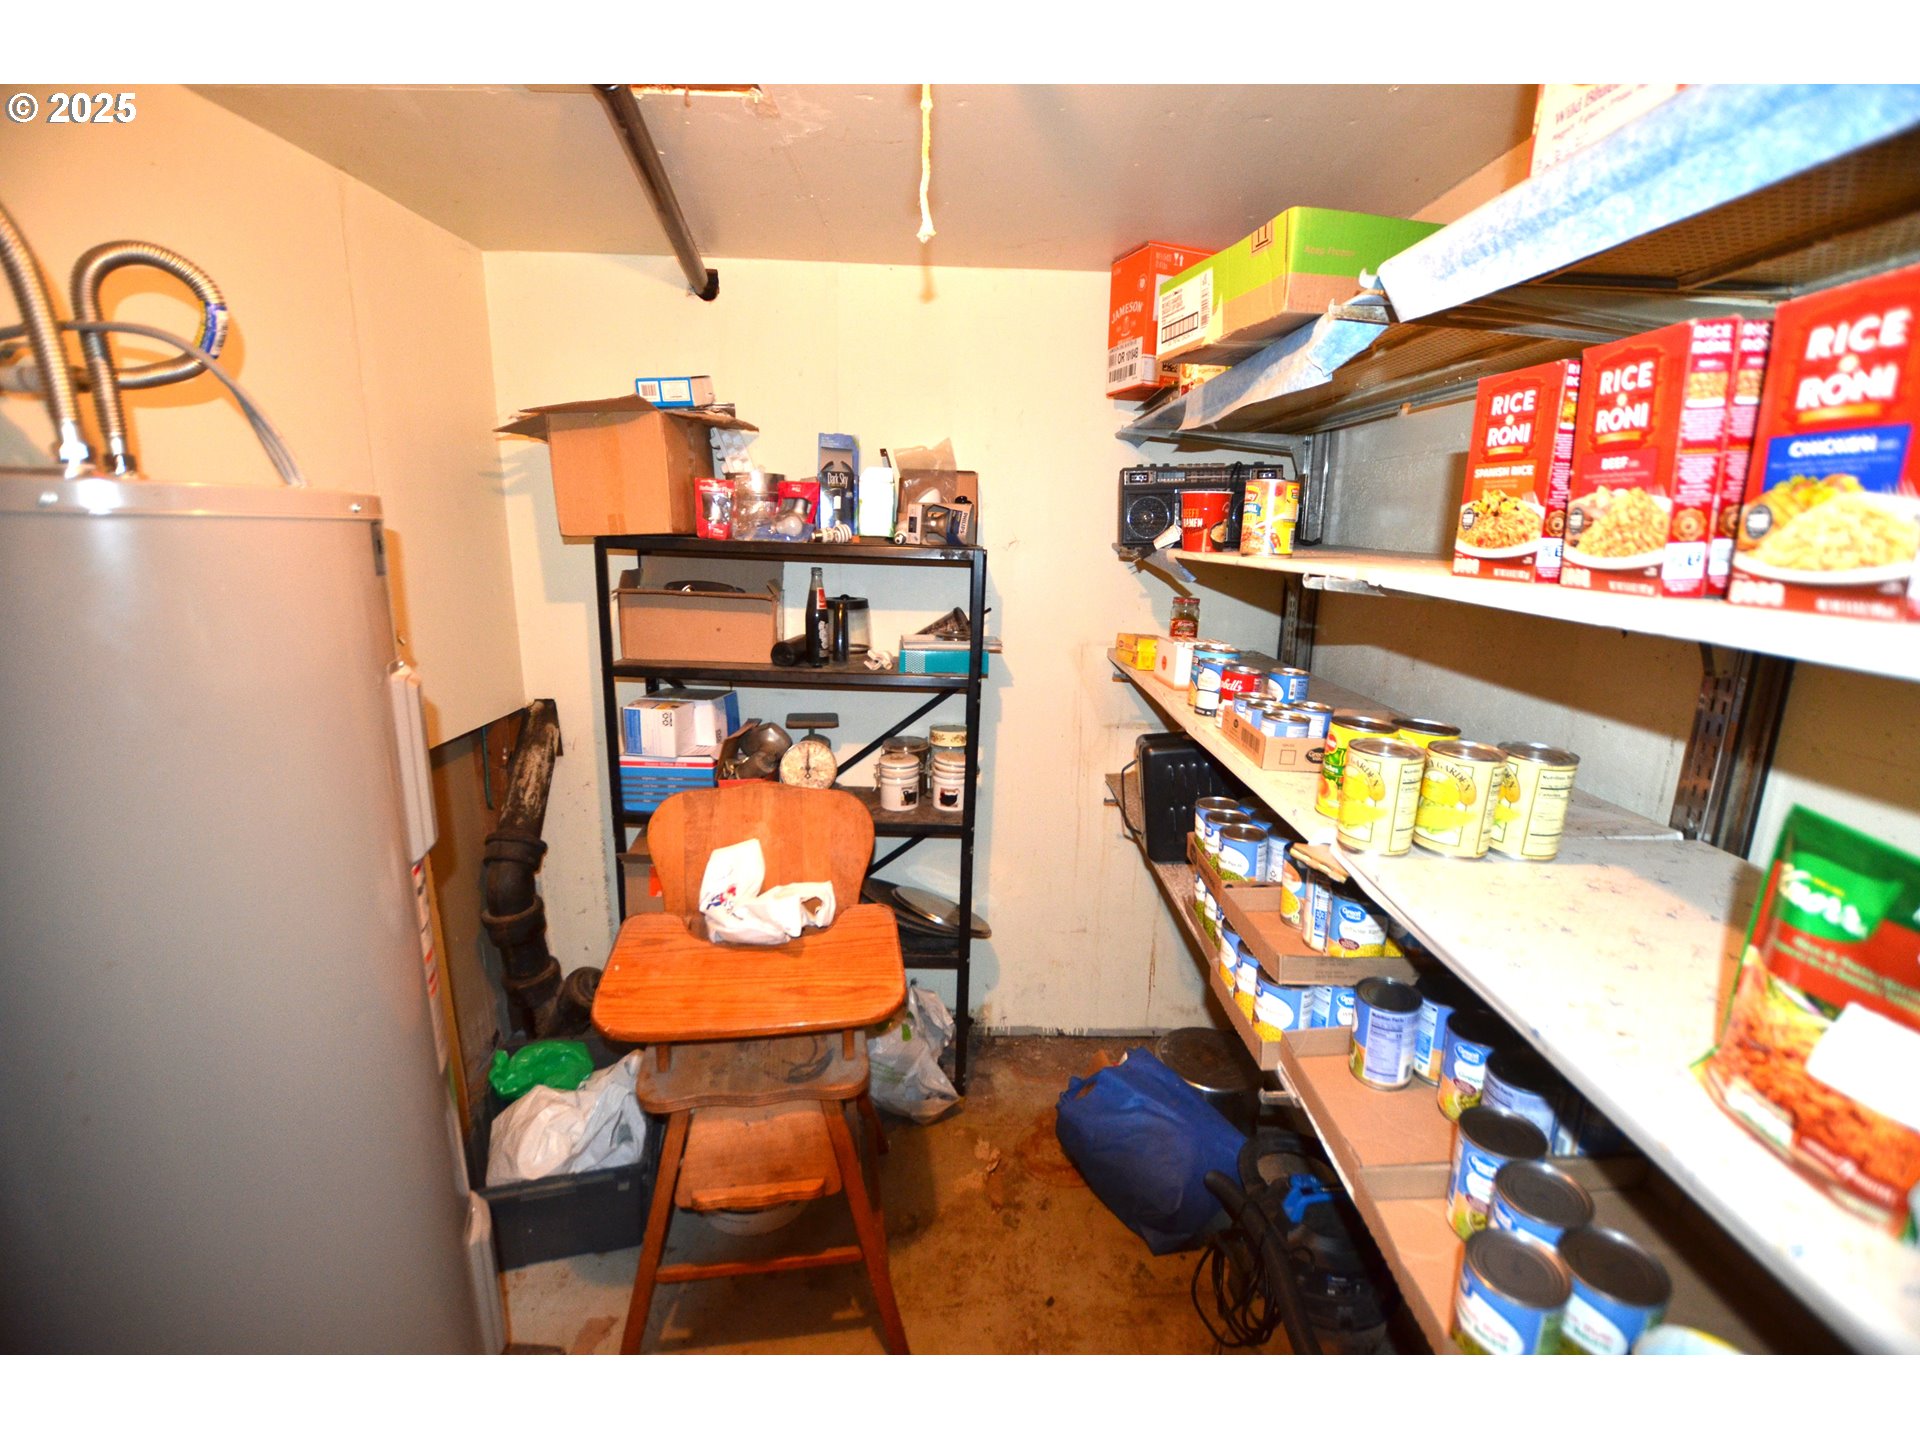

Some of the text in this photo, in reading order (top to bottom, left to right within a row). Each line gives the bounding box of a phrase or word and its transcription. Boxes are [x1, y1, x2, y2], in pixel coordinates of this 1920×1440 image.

[1111, 299, 1144, 324] JAMESON
[1805, 307, 1914, 361] RICE
[1599, 360, 1656, 396] RICE
[1795, 362, 1899, 410] RONI
[1490, 389, 1537, 416] RICE
[1595, 402, 1650, 434] RONI
[1487, 422, 1532, 447] RONI
[827, 472, 849, 488] Dark Sky
[1510, 464, 1534, 476] RICE
[960, 512, 969, 534] PHILIPS
[1342, 905, 1362, 917] Great
